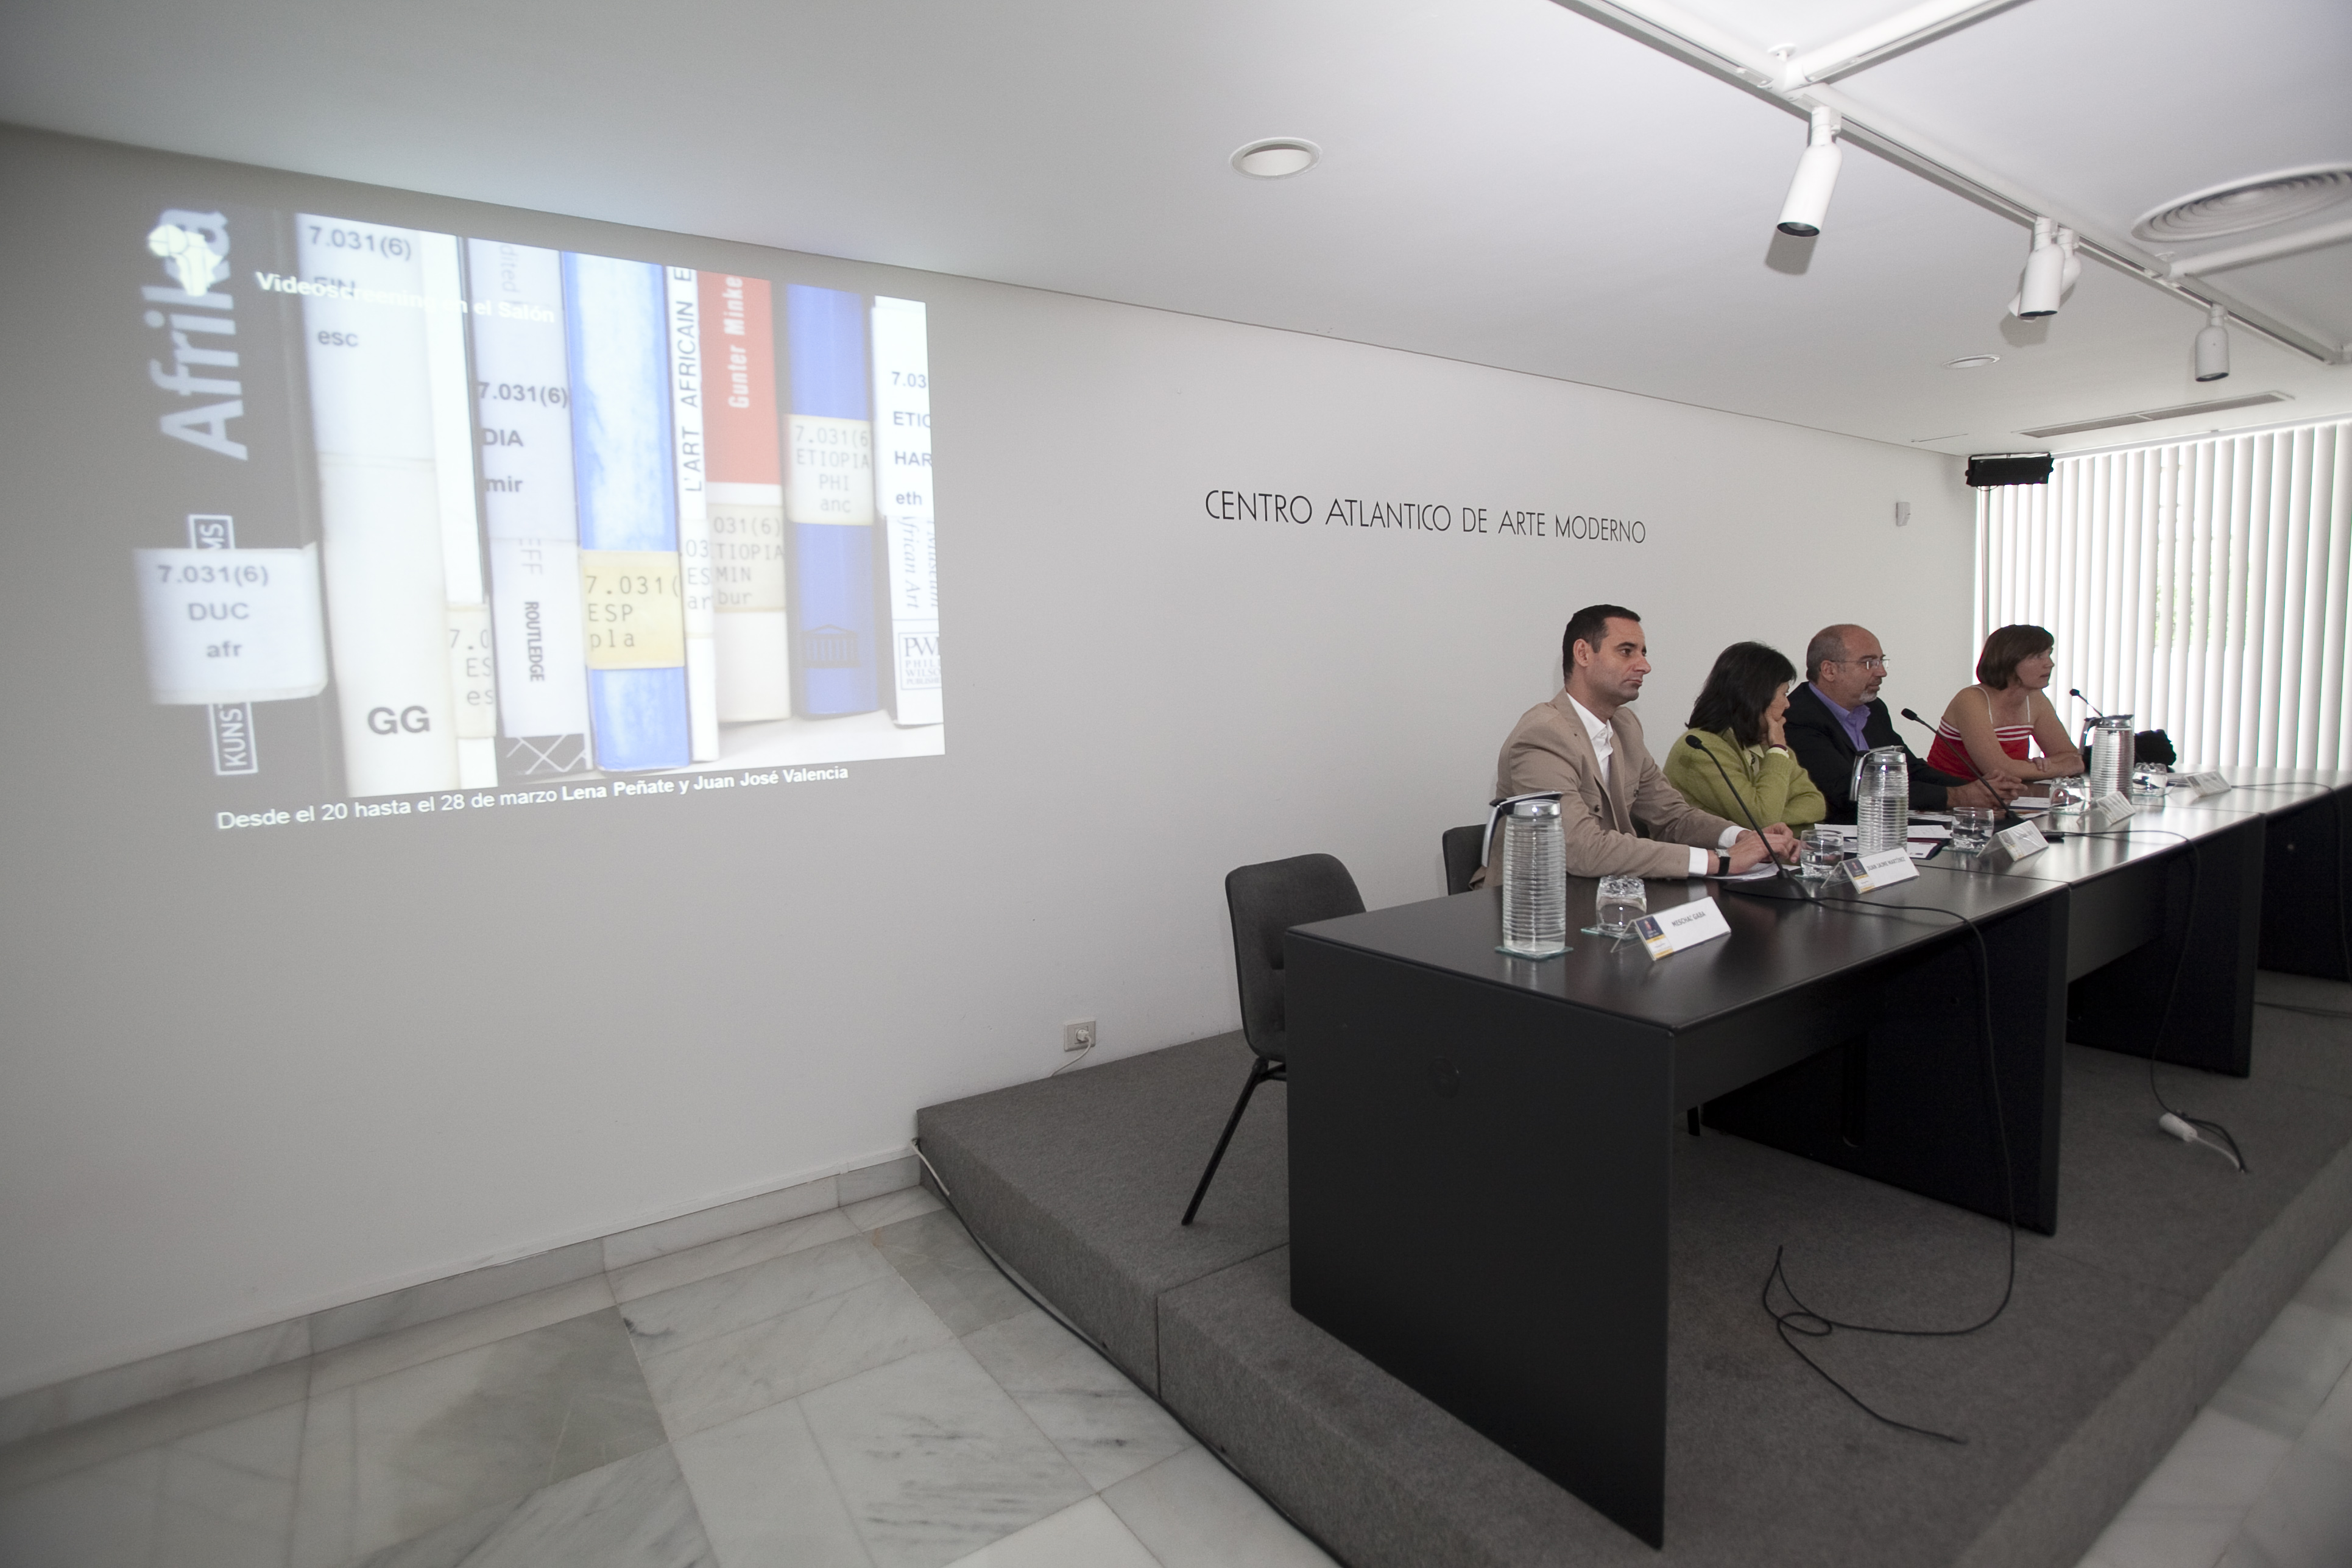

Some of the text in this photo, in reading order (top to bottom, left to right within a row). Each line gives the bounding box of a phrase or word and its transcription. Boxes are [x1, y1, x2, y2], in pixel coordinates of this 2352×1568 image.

[309, 225, 412, 262] 7.031(6)
[255, 270, 436, 313] Videoscreening
[473, 298, 492, 316] el
[498, 302, 555, 323] Salón
[317, 330, 359, 348] esc
[676, 300, 699, 408] AFRICAIN
[478, 381, 568, 409] 7.031(6)
[483, 428, 524, 447] DIA
[681, 426, 702, 492] L'ART
[795, 448, 871, 470] ETIOPIA
[894, 450, 933, 467] HAR
[487, 475, 523, 494] mir
[819, 474, 850, 492] PHI
[819, 496, 852, 514] anc
[895, 490, 923, 506] eth
[1205, 489, 1646, 544] CENTRO ATLANTICO DE ARTE MODERNO
[157, 564, 270, 587] 7.031(6)
[715, 565, 752, 584] MIN
[717, 588, 752, 606] bur
[905, 579, 922, 609] Art
[187, 601, 251, 622] DUC
[588, 603, 634, 623] ESP
[205, 640, 244, 658] afr
[523, 600, 546, 683] ROUTLEDGE
[589, 629, 636, 651] pla
[366, 704, 432, 736] GG
[217, 704, 249, 768] KUNS
[216, 766, 849, 832] Desde el 20 hasta el 28 de marzo Lena Peñate y Juan José Valencia
